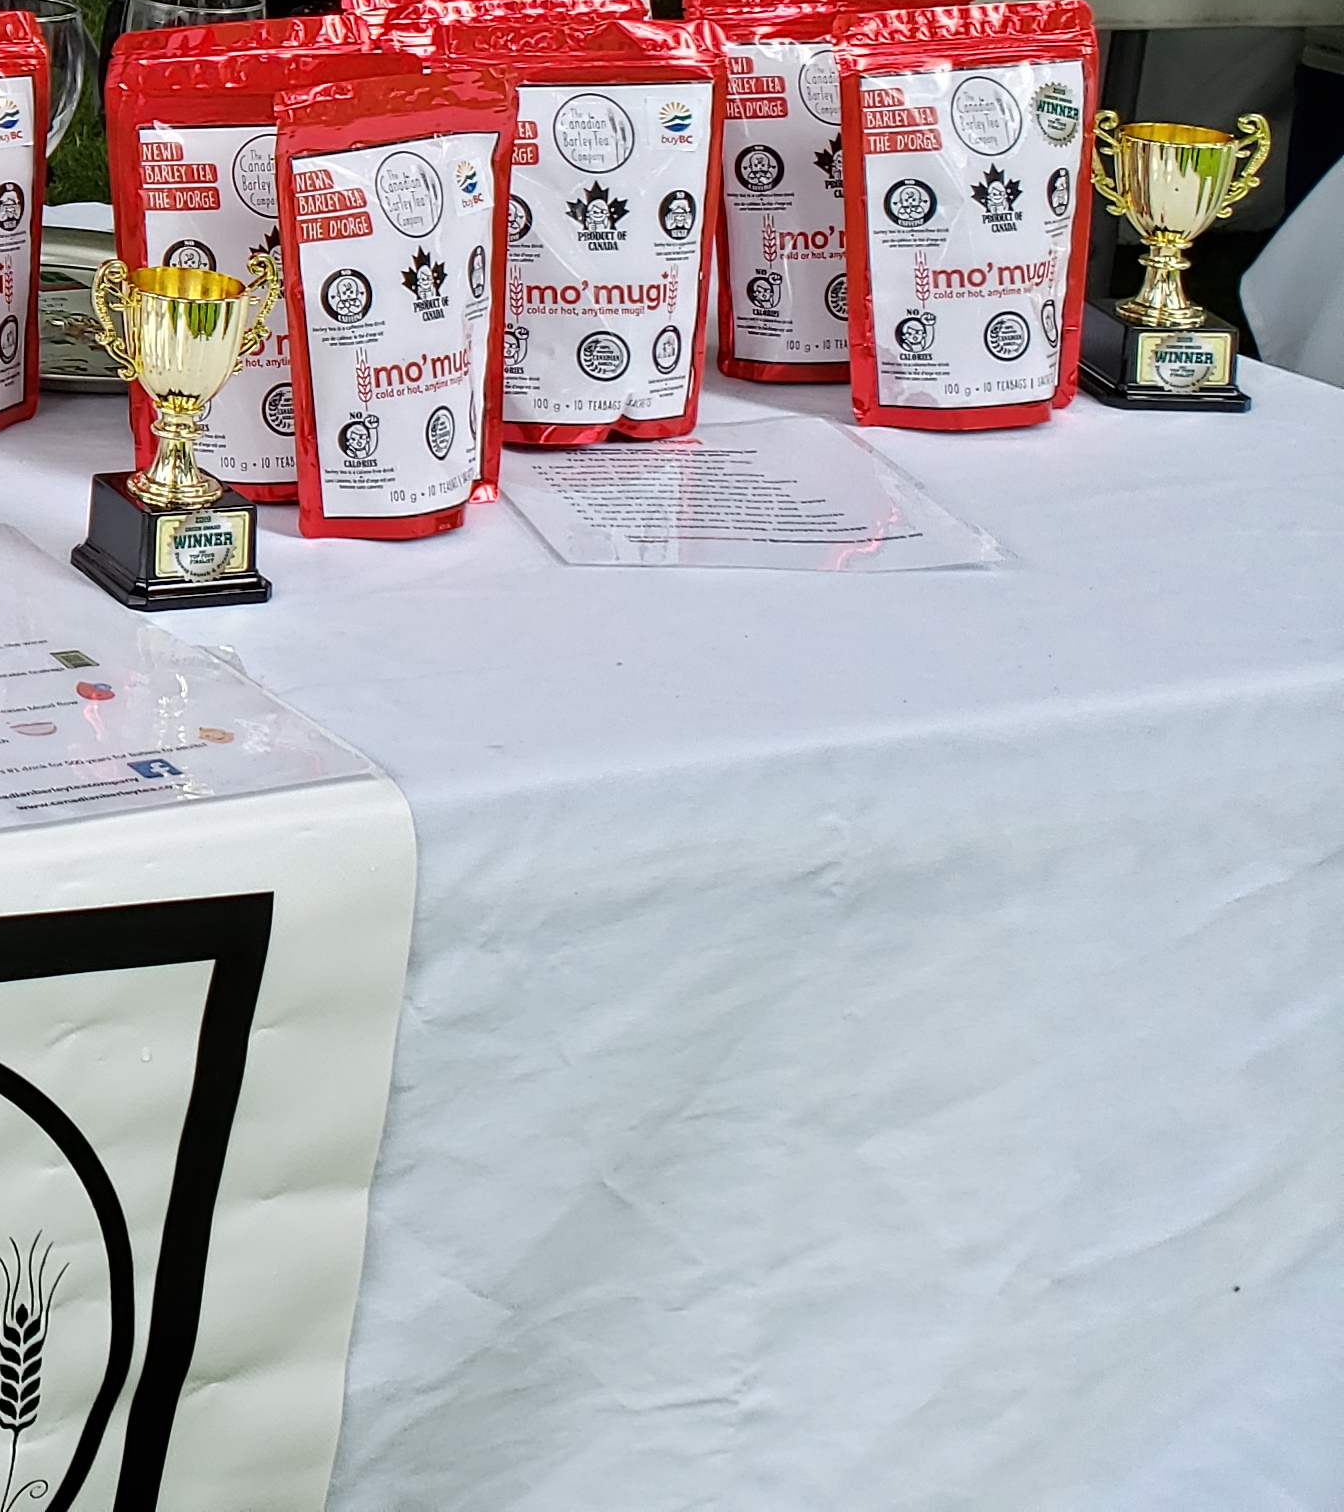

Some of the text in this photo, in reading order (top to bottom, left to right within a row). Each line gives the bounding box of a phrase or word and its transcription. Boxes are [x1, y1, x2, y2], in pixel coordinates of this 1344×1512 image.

[866, 106, 935, 127] BARLEY TEA
[1035, 100, 1080, 121] WINNER
[661, 134, 693, 146] buyBC
[869, 131, 939, 151] THÉ D'ORGE
[145, 164, 214, 183] BARLEY TEA
[148, 188, 216, 208] THÉ D'ORGE
[298, 189, 363, 214] BARLEY TEA
[301, 216, 369, 240] THÉ D'ORGE
[526, 271, 668, 311] mo'mugi
[526, 306, 547, 315] cold
[548, 307, 559, 315] or
[581, 306, 620, 317] anytime
[1155, 350, 1214, 365] WINNER
[173, 532, 233, 549] WINNER
